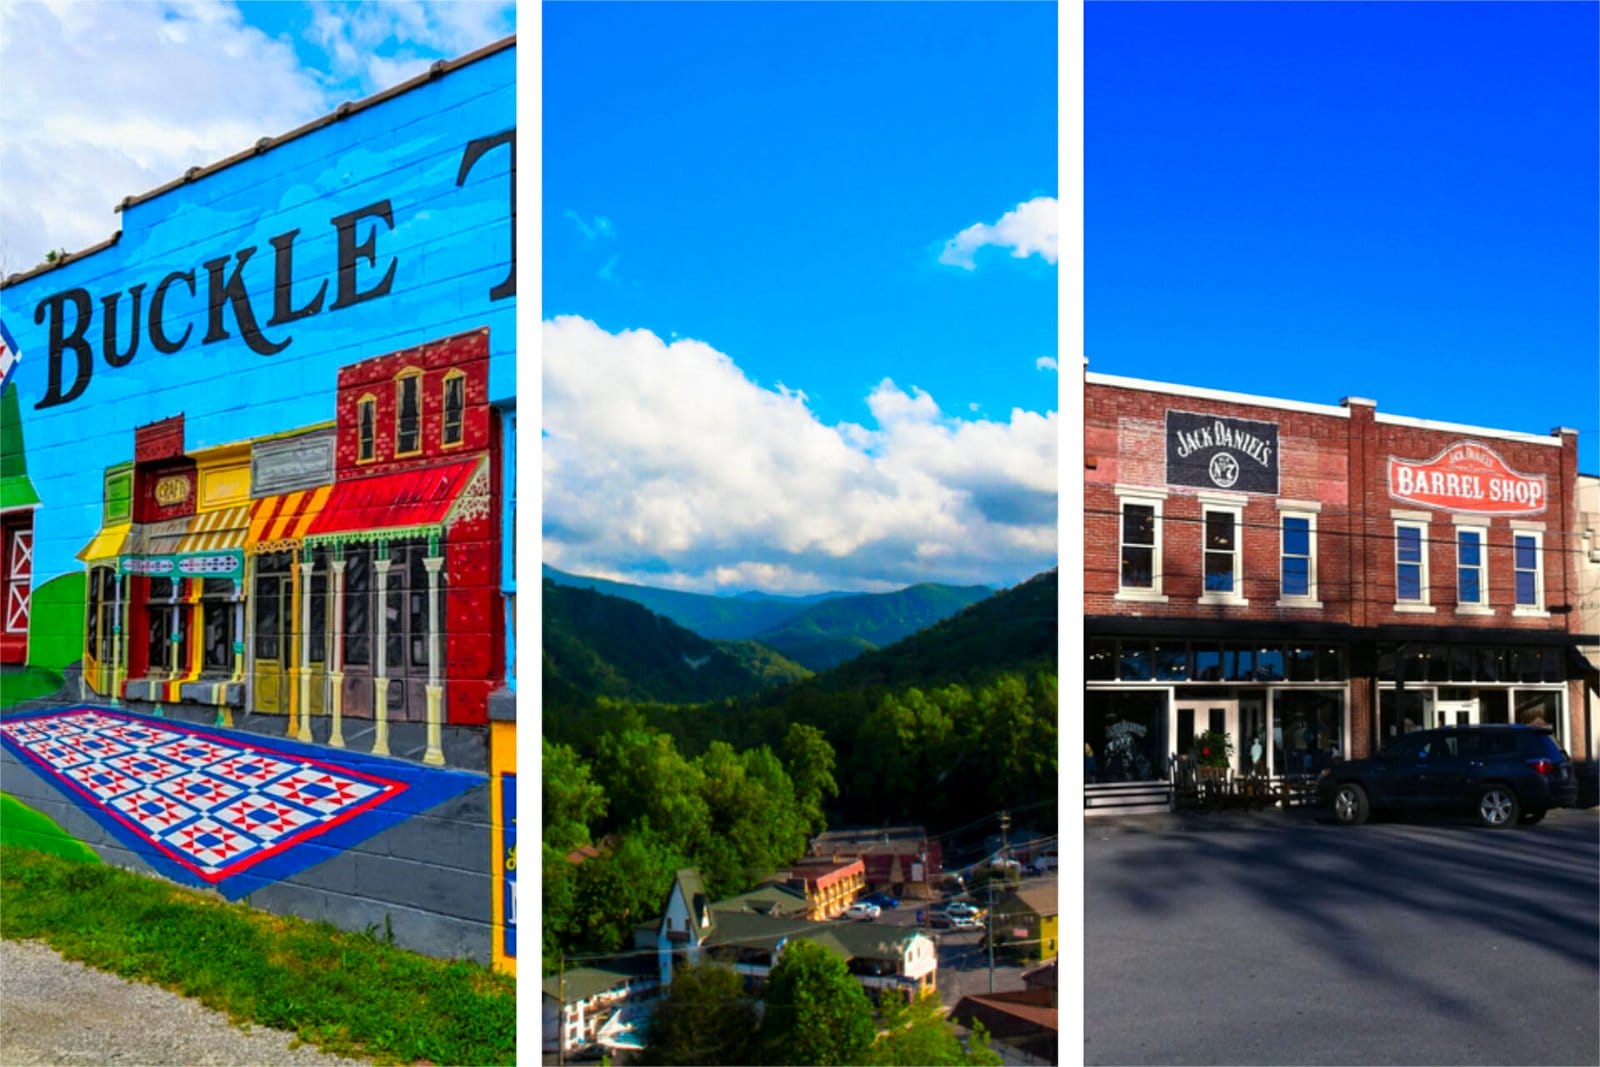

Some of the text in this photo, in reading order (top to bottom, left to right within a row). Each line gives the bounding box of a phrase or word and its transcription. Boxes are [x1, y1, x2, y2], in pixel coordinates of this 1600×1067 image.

[34, 198, 398, 410] BUCKLE
[1177, 426, 1214, 458] JACK
[1397, 466, 1542, 508] BARREL SHOP
